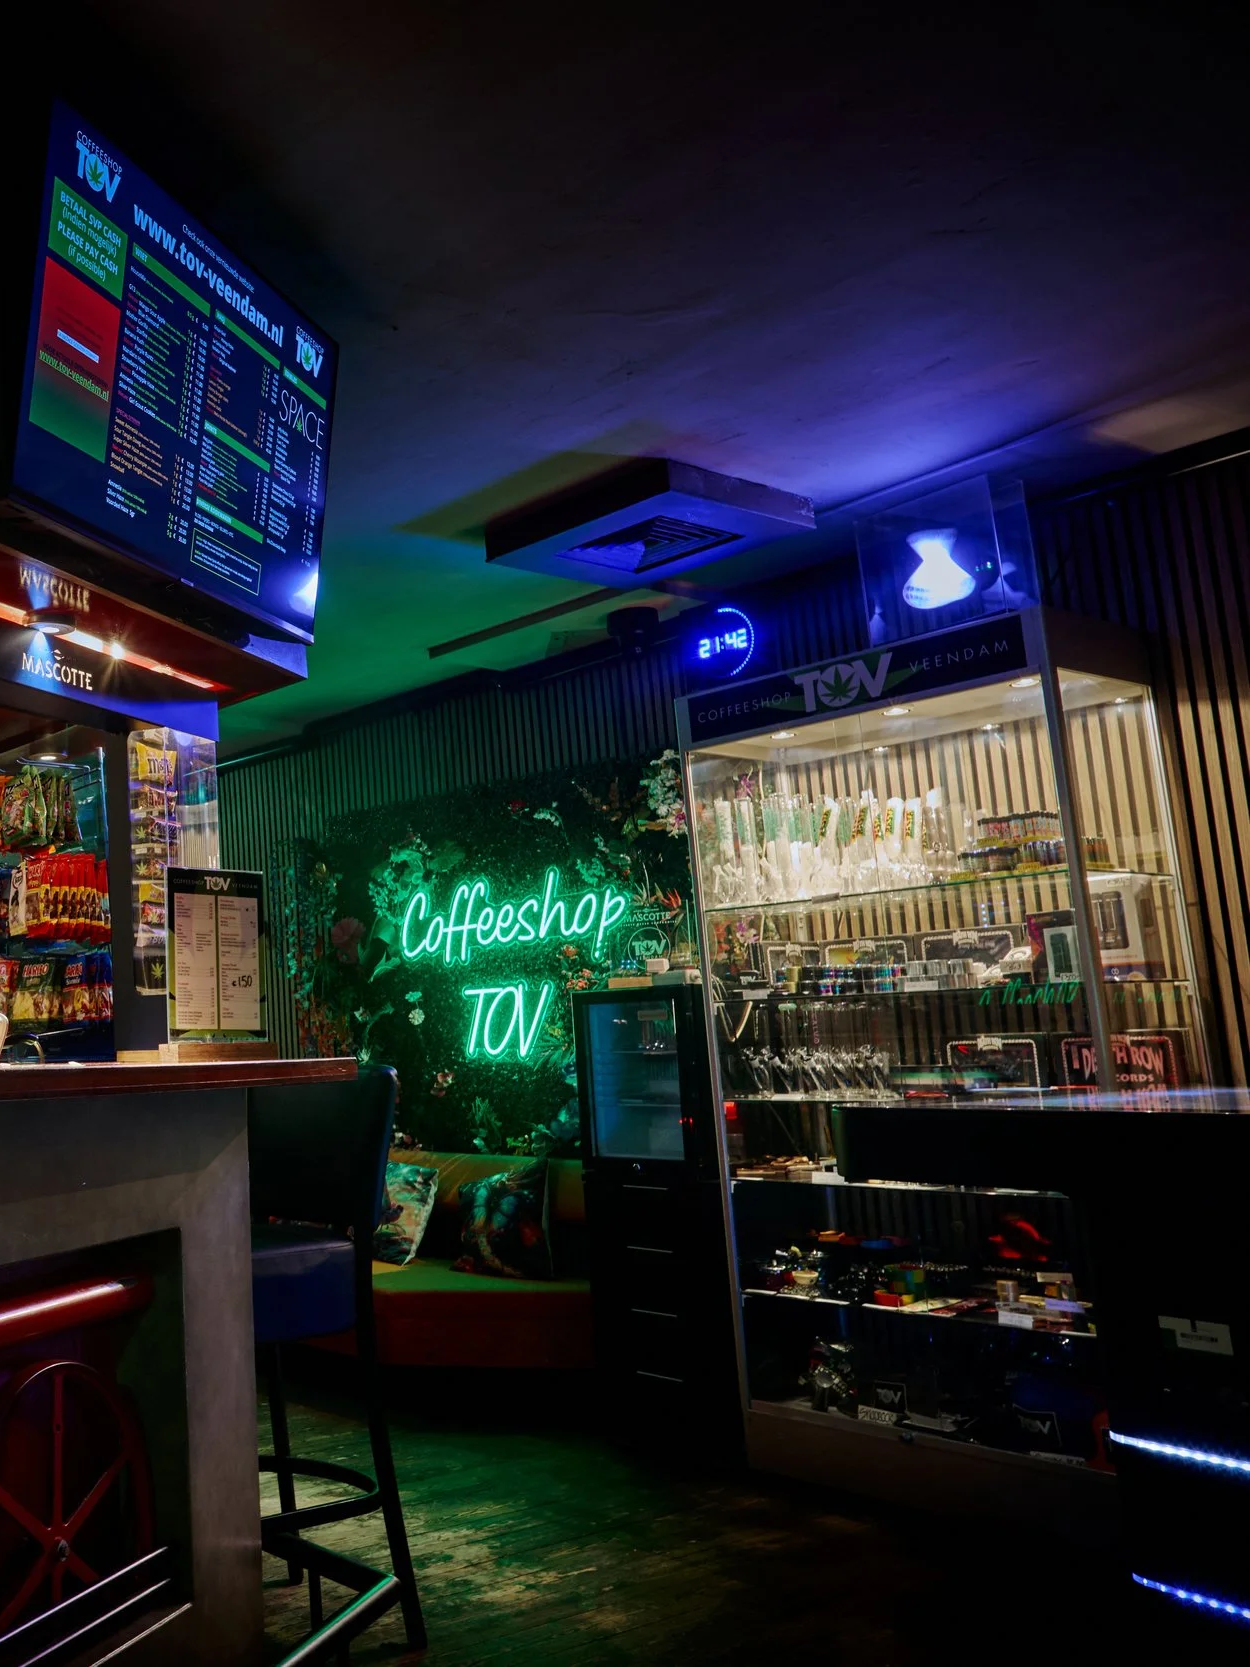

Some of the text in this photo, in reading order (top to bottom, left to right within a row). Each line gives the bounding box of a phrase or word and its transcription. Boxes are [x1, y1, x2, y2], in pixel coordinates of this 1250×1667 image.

[76, 130, 123, 176] COFFEESHOP
[76, 138, 121, 203] TOV
[60, 190, 122, 248] BETAAL SVP CASH
[57, 220, 119, 276] PLEASE PAY CASH
[133, 204, 284, 348] www.tov-veendam.nl
[39, 350, 110, 403] www.tov-veendam.nl
[296, 333, 324, 378] TOV
[279, 389, 326, 451] SPACE
[699, 628, 748, 659] 21:42
[21, 652, 93, 691] MASCOTTE
[697, 640, 1009, 723] COFFEESHOP TOV VEENDAM
[204, 876, 231, 891] TOV
[402, 871, 626, 962] Coffeeshop
[623, 911, 672, 924] MASCOTTE
[22, 963, 50, 978] HARIBO
[632, 939, 667, 956] TOV
[464, 984, 549, 1057] TOV
[1130, 1045, 1165, 1079] ROW
[876, 1388, 902, 1404] TOV
